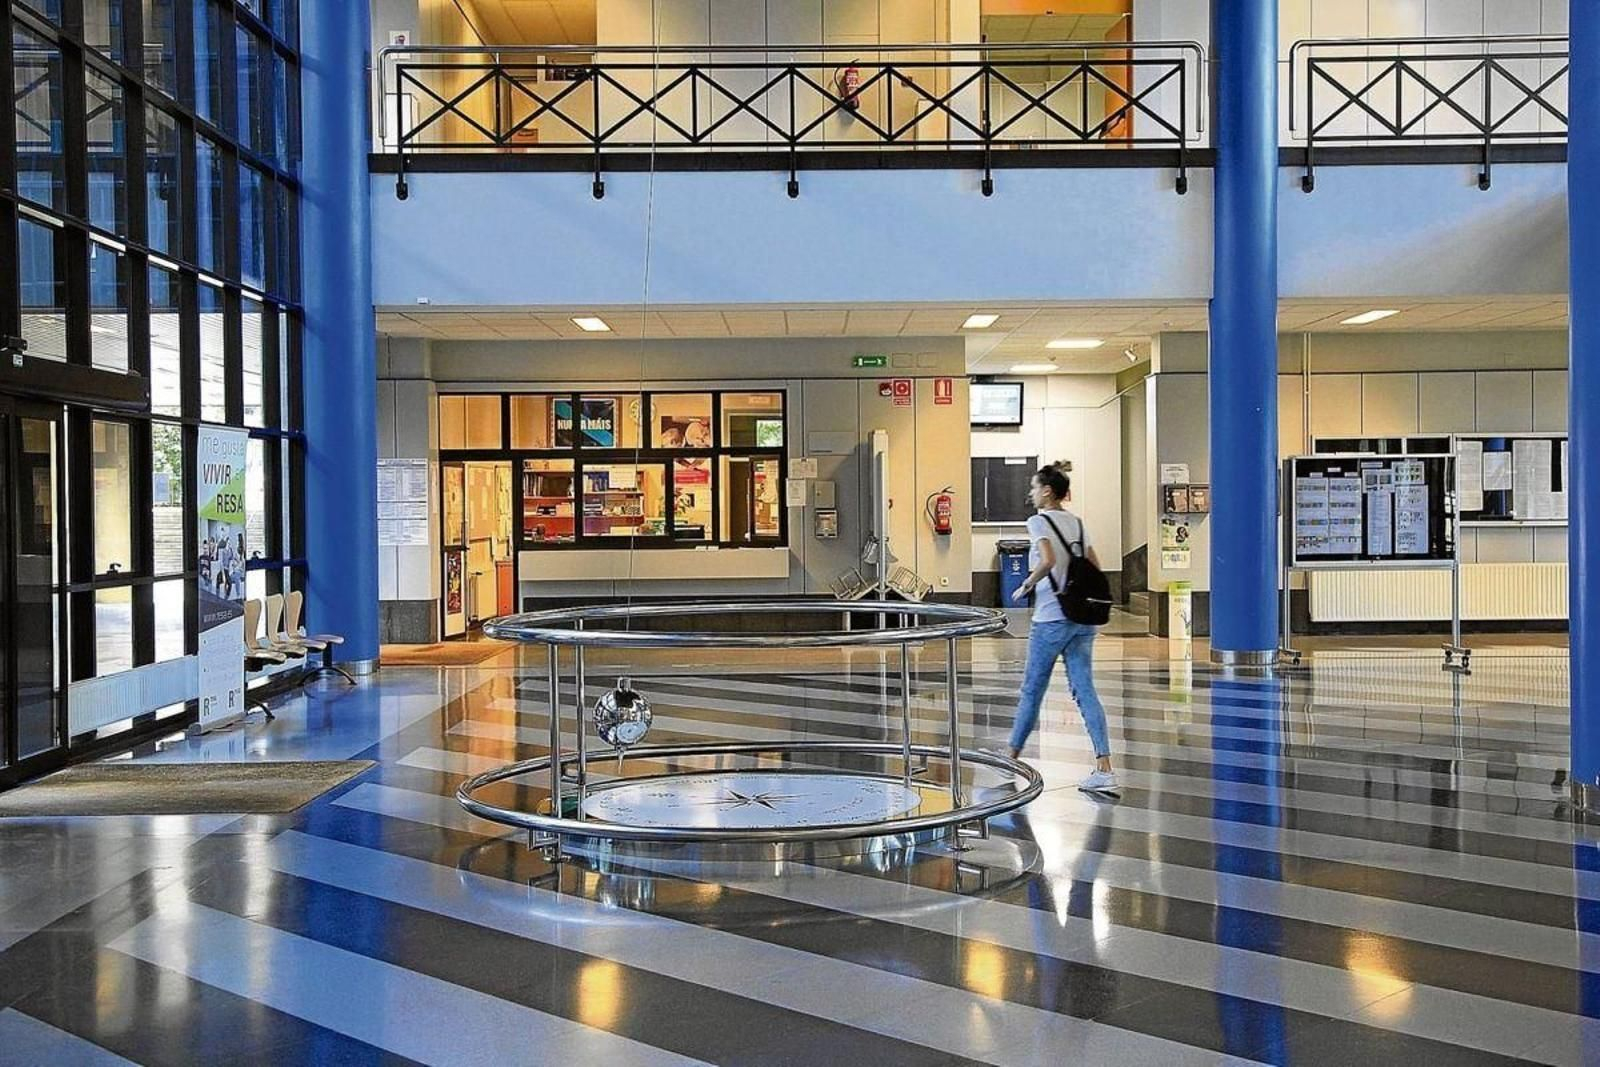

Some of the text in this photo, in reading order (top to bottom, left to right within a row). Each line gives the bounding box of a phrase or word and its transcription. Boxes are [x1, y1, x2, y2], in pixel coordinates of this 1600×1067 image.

[557, 417, 611, 430] NUNA MÁIS
[202, 436, 219, 454] me
[203, 464, 231, 485] VIVIR
[217, 494, 243, 513] RESA
